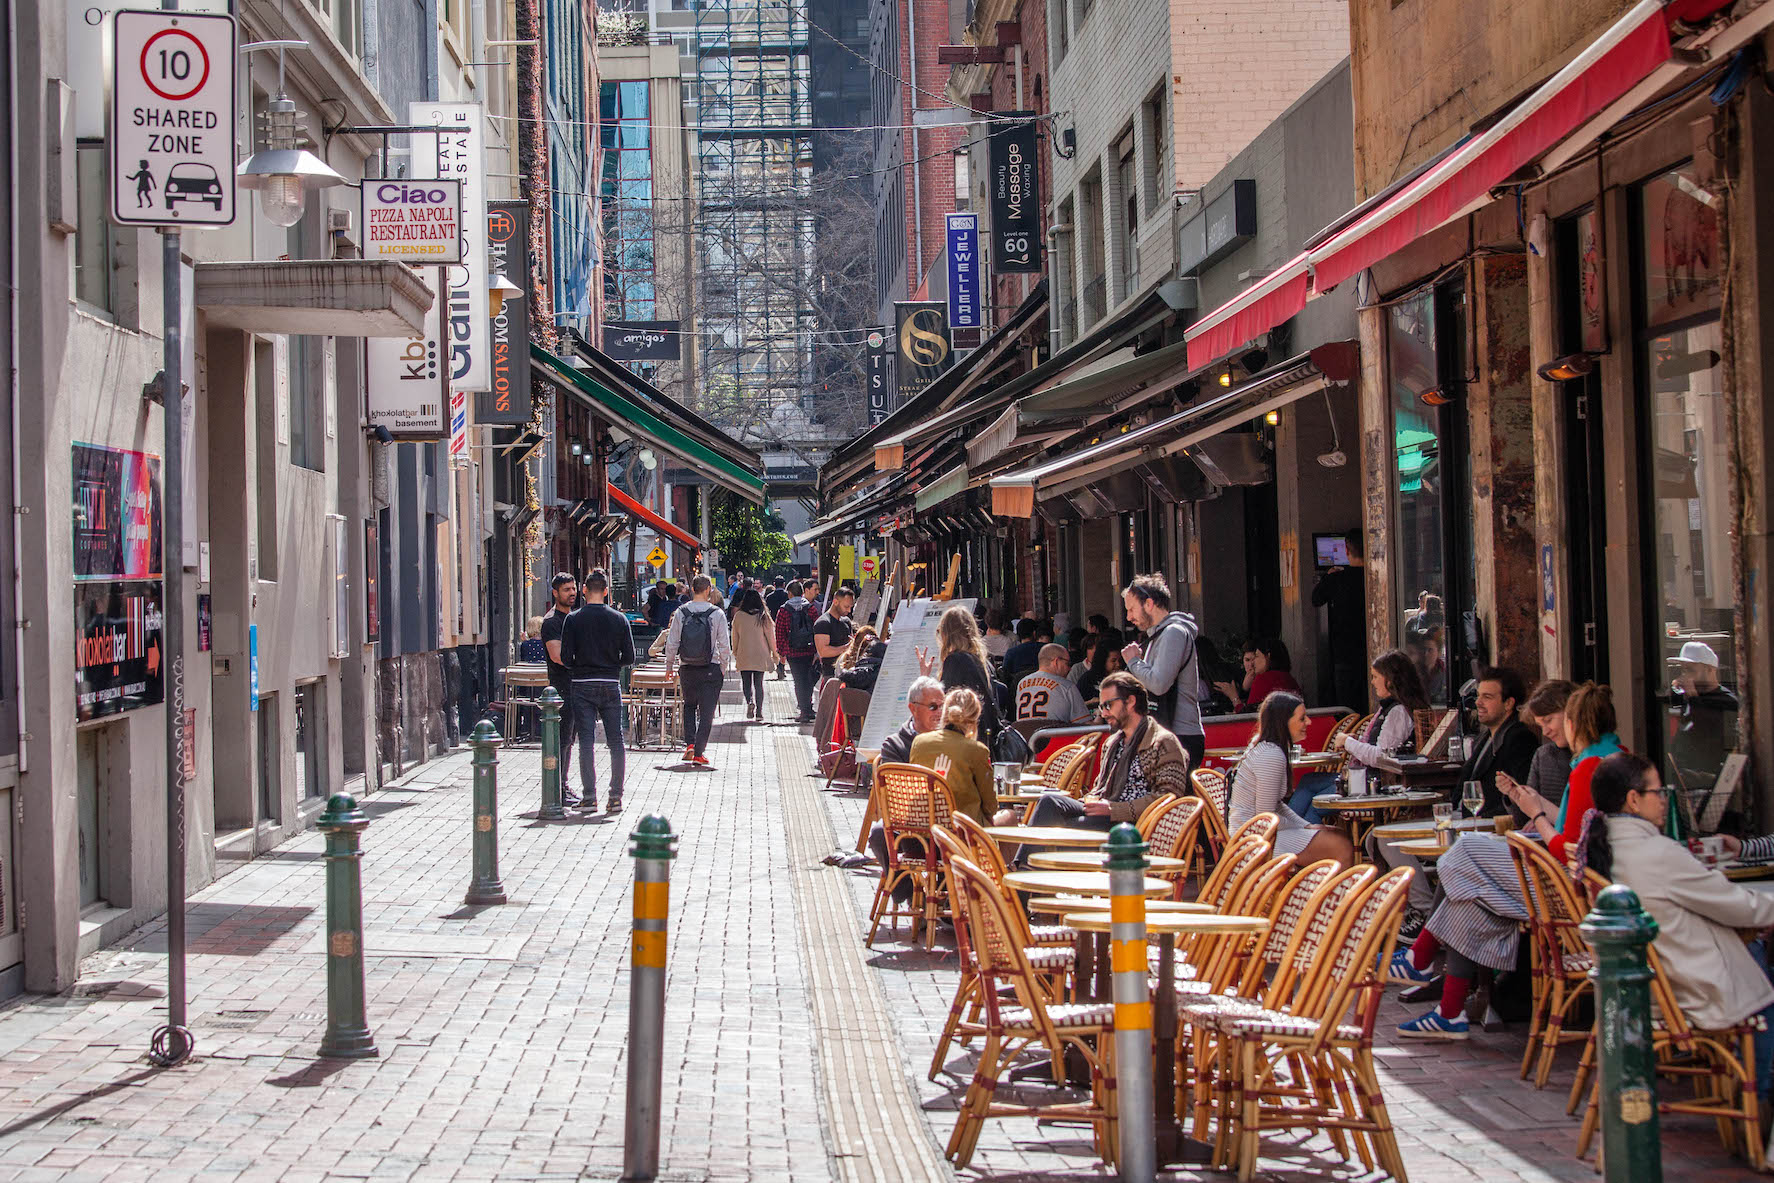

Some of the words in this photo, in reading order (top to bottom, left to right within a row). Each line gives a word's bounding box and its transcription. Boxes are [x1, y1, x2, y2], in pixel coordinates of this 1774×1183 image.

[159, 49, 191, 81] 10
[133, 107, 217, 129] SHARED
[148, 134, 203, 154] ZONE
[998, 165, 1006, 199] Beauty
[1008, 143, 1023, 219] Massage
[1024, 163, 1032, 198] Waxing
[377, 184, 447, 204] Ciao
[370, 208, 405, 222] PIZZA
[409, 207, 453, 222] NAPOLI
[370, 223, 456, 241] RESTAURANT
[378, 245, 446, 254] LICENSED
[1005, 238, 1028, 253] 60
[954, 231, 972, 325] JEWELLERS
[623, 333, 666, 348] amigos
[1018, 691, 1050, 720] 22
